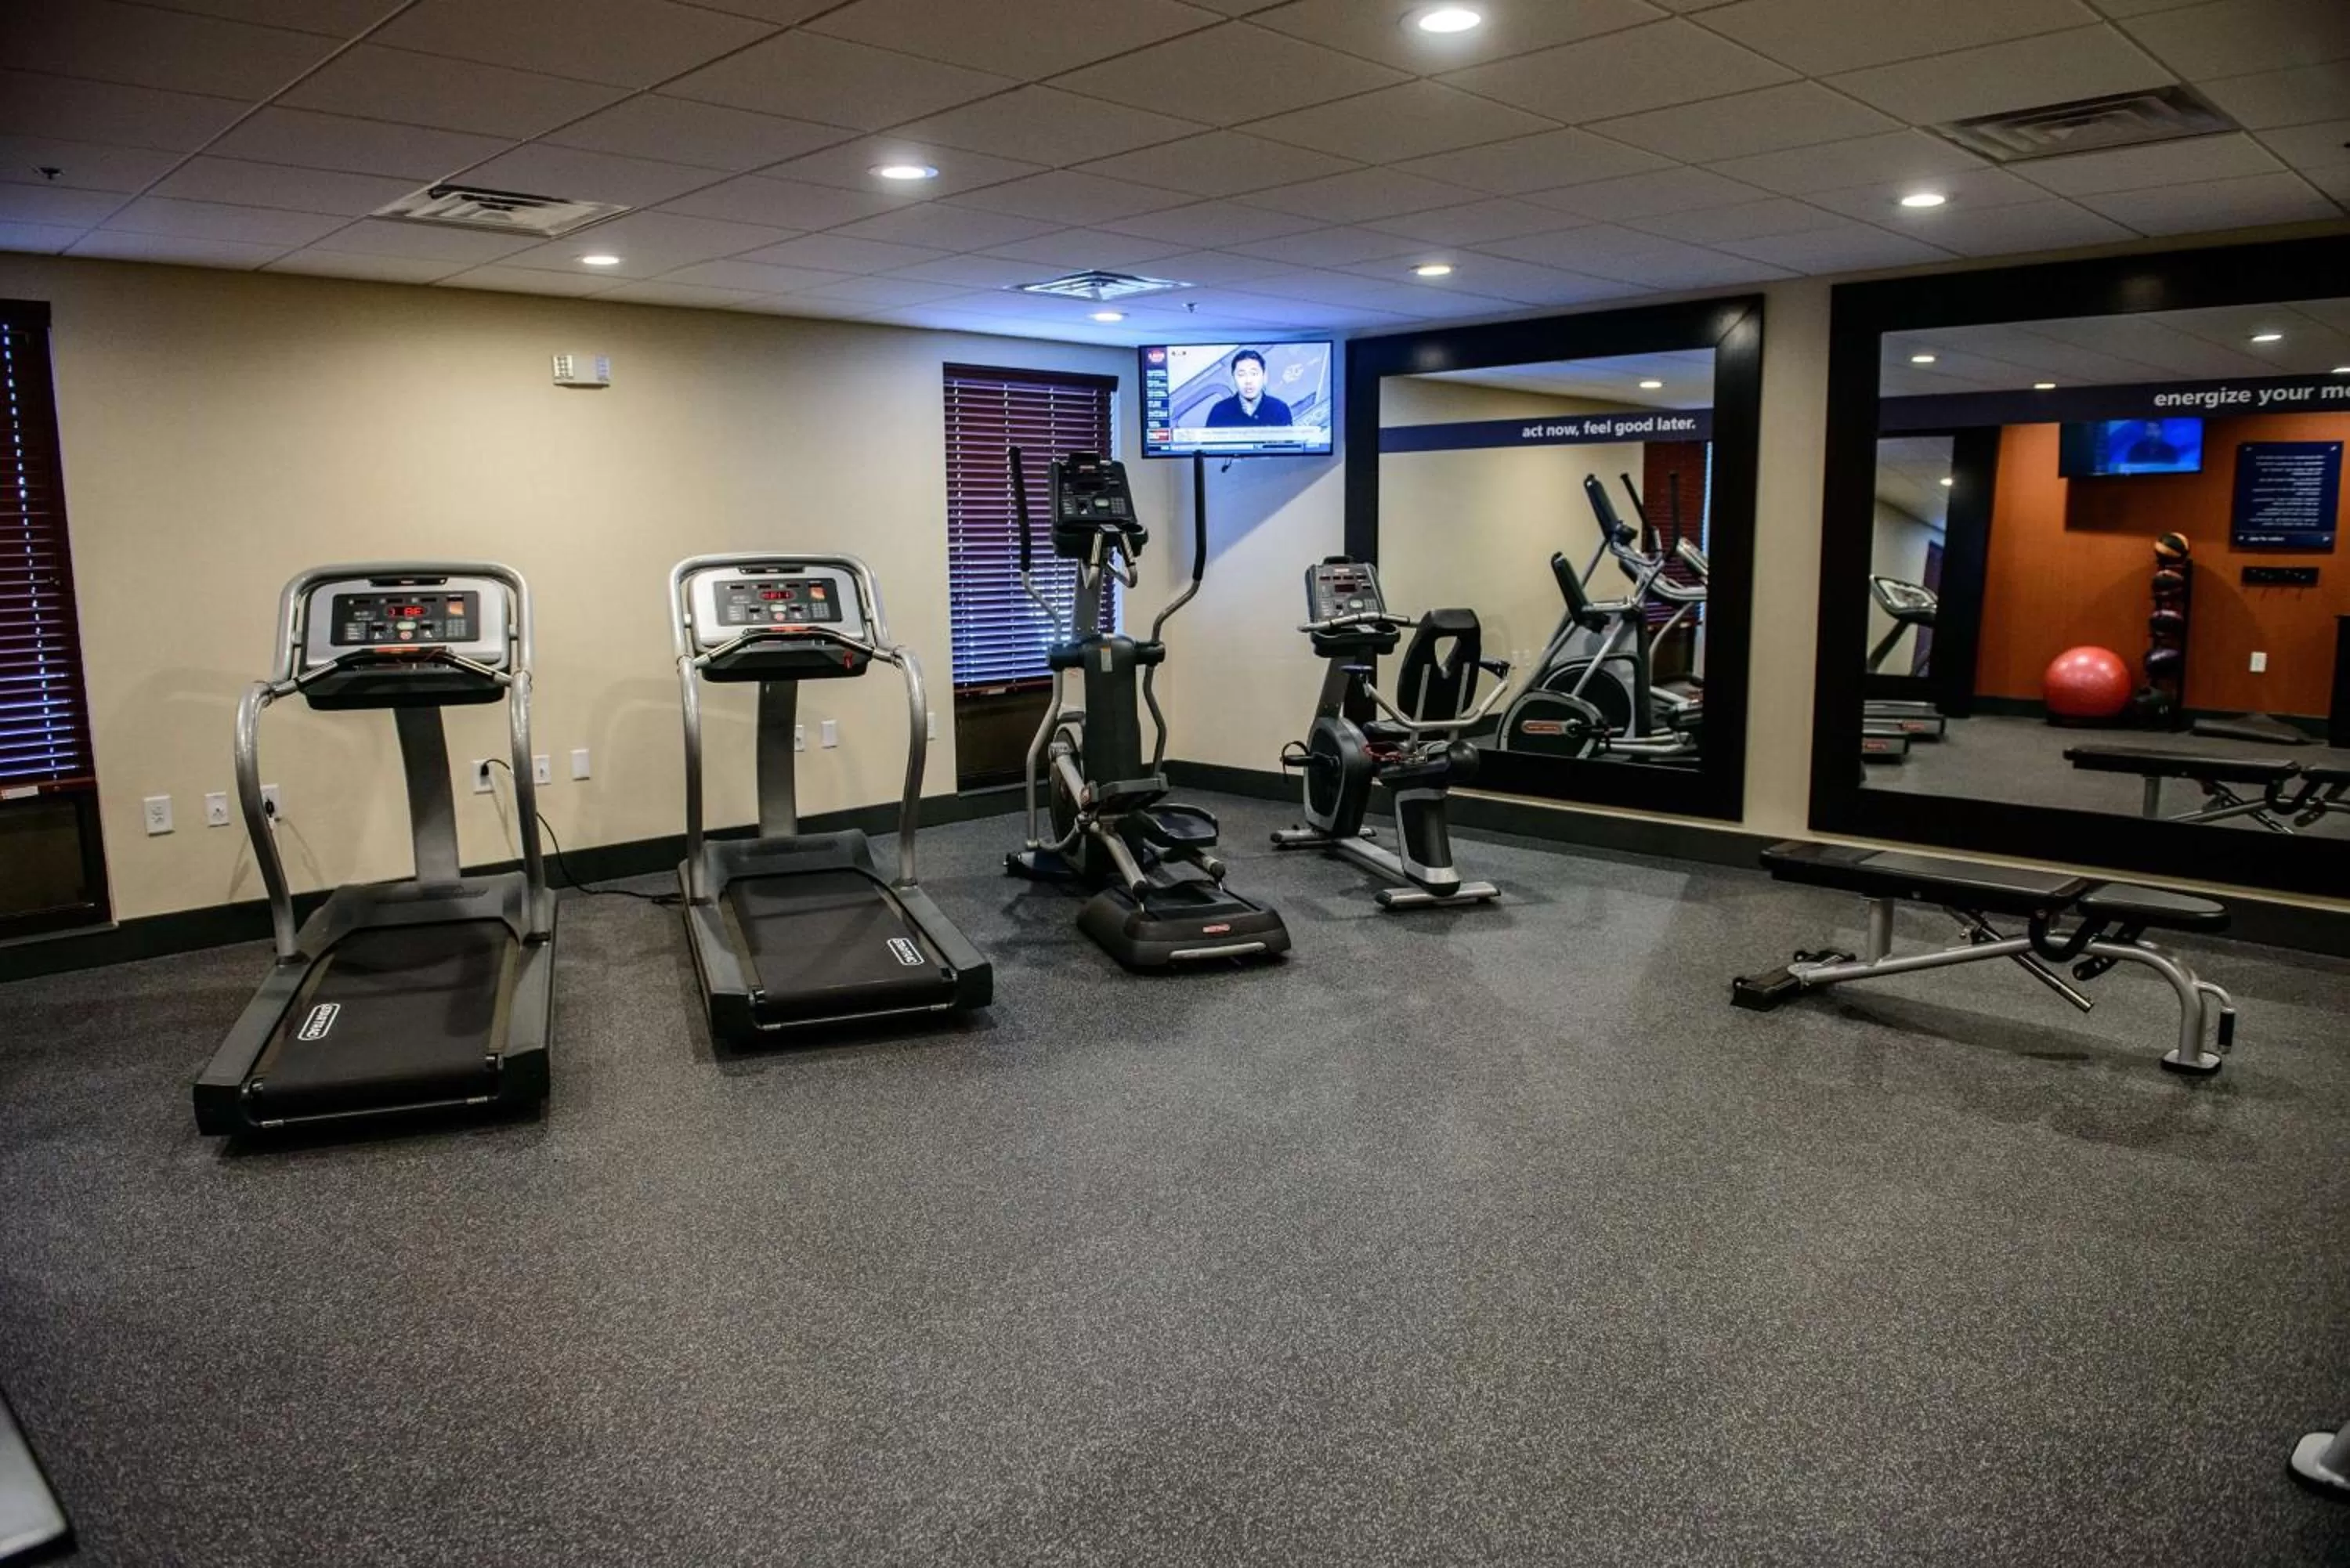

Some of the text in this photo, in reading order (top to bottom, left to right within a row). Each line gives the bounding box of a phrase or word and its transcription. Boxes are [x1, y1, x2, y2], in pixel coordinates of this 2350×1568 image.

[2153, 387, 2252, 409] energize
[2258, 387, 2315, 406] your
[1522, 417, 1696, 438] act now, feel good later.
